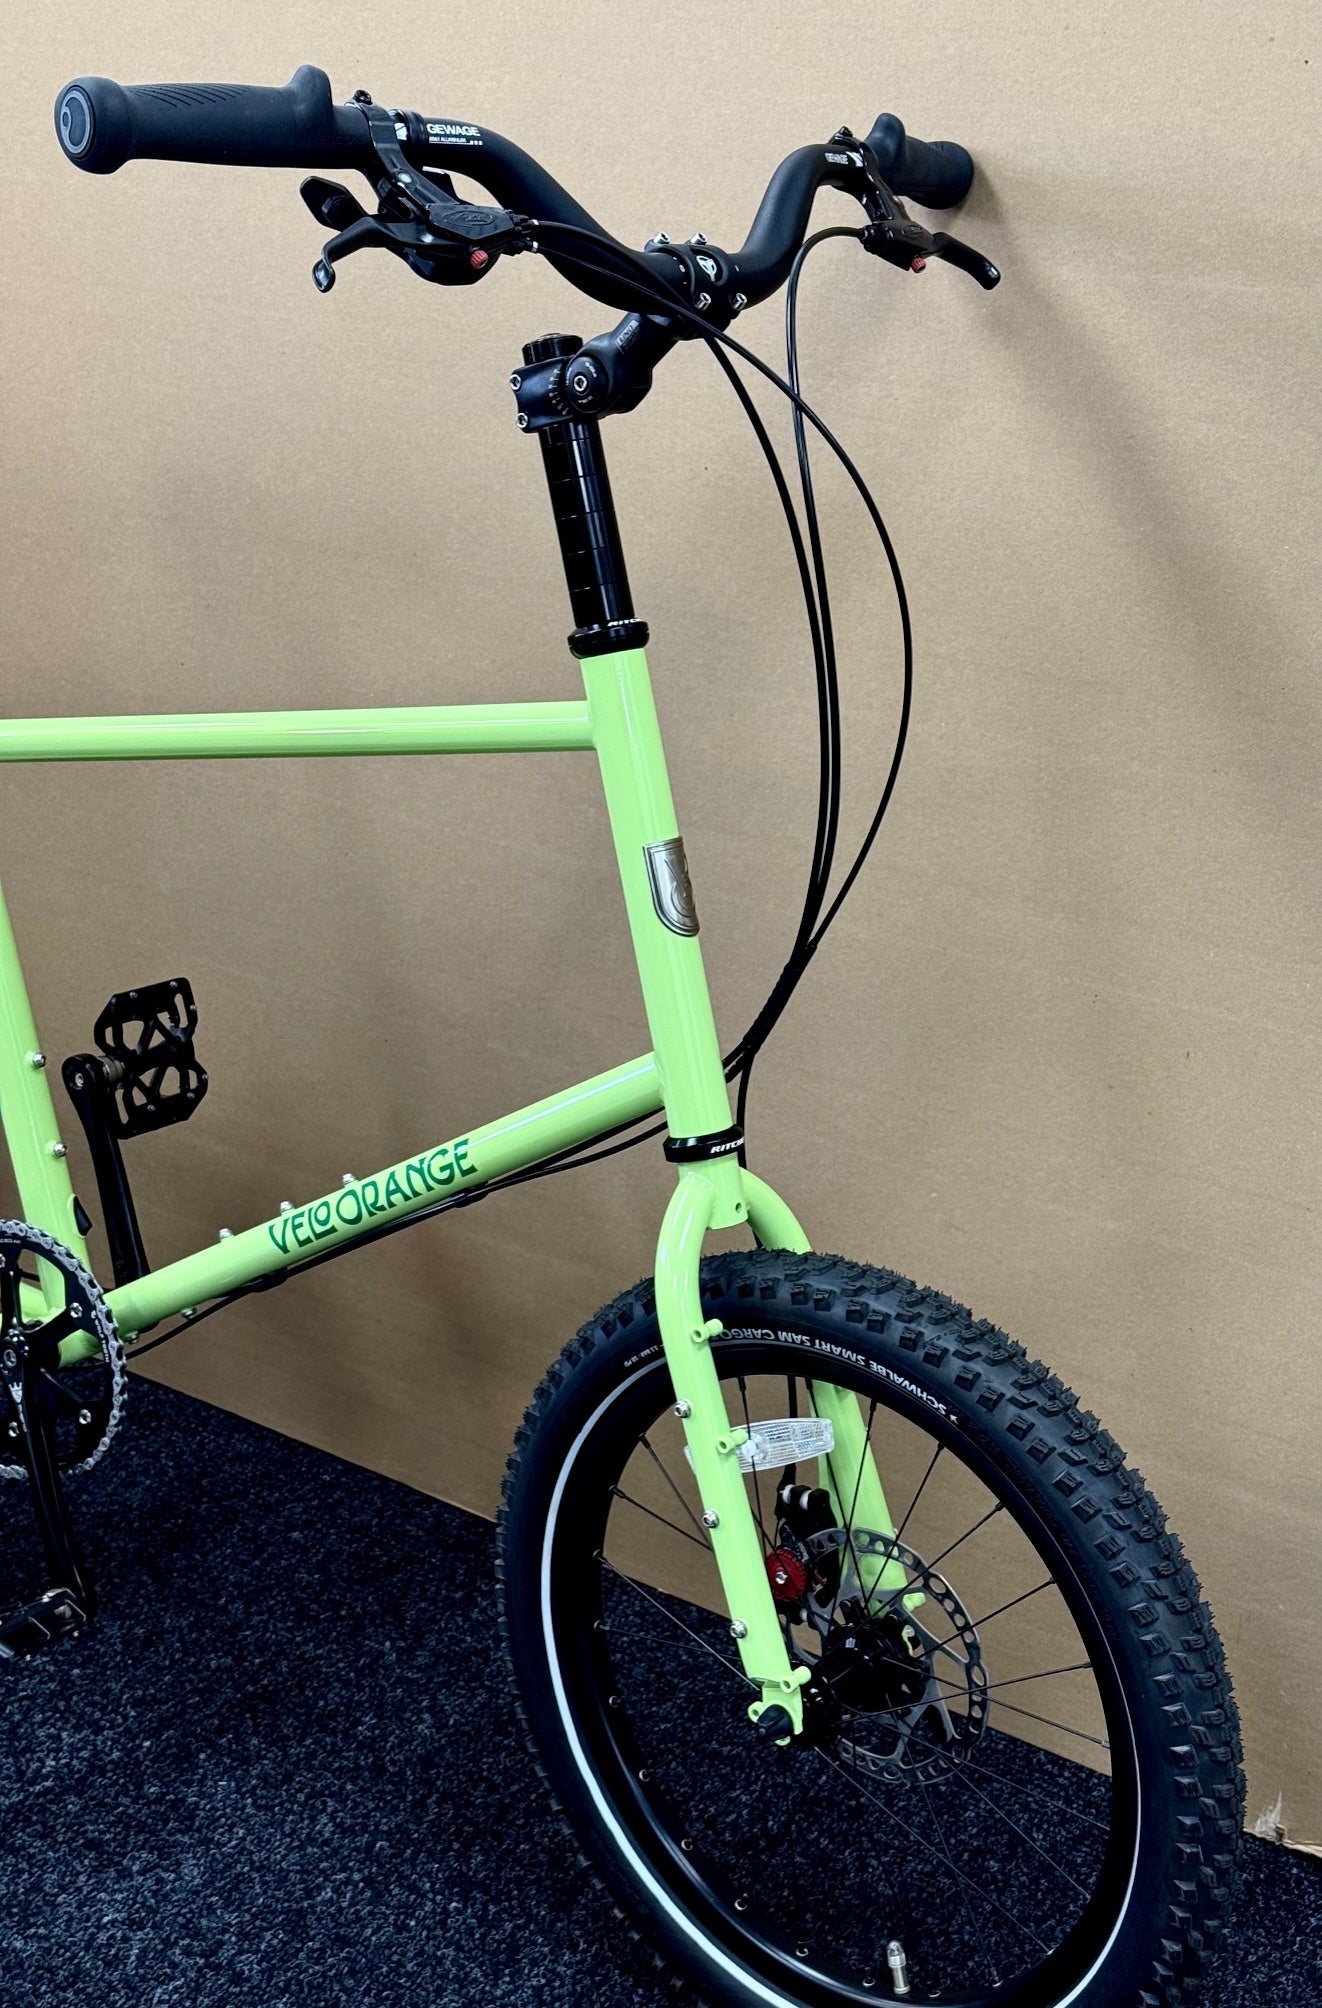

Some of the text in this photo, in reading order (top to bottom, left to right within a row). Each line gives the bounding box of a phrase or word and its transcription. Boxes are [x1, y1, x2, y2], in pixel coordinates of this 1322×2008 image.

[426, 123, 481, 137] GEWAGE
[268, 1138, 478, 1254] VELO ORANGE
[720, 1328, 947, 1414] SCHWALBE SMART SAM CARGO
